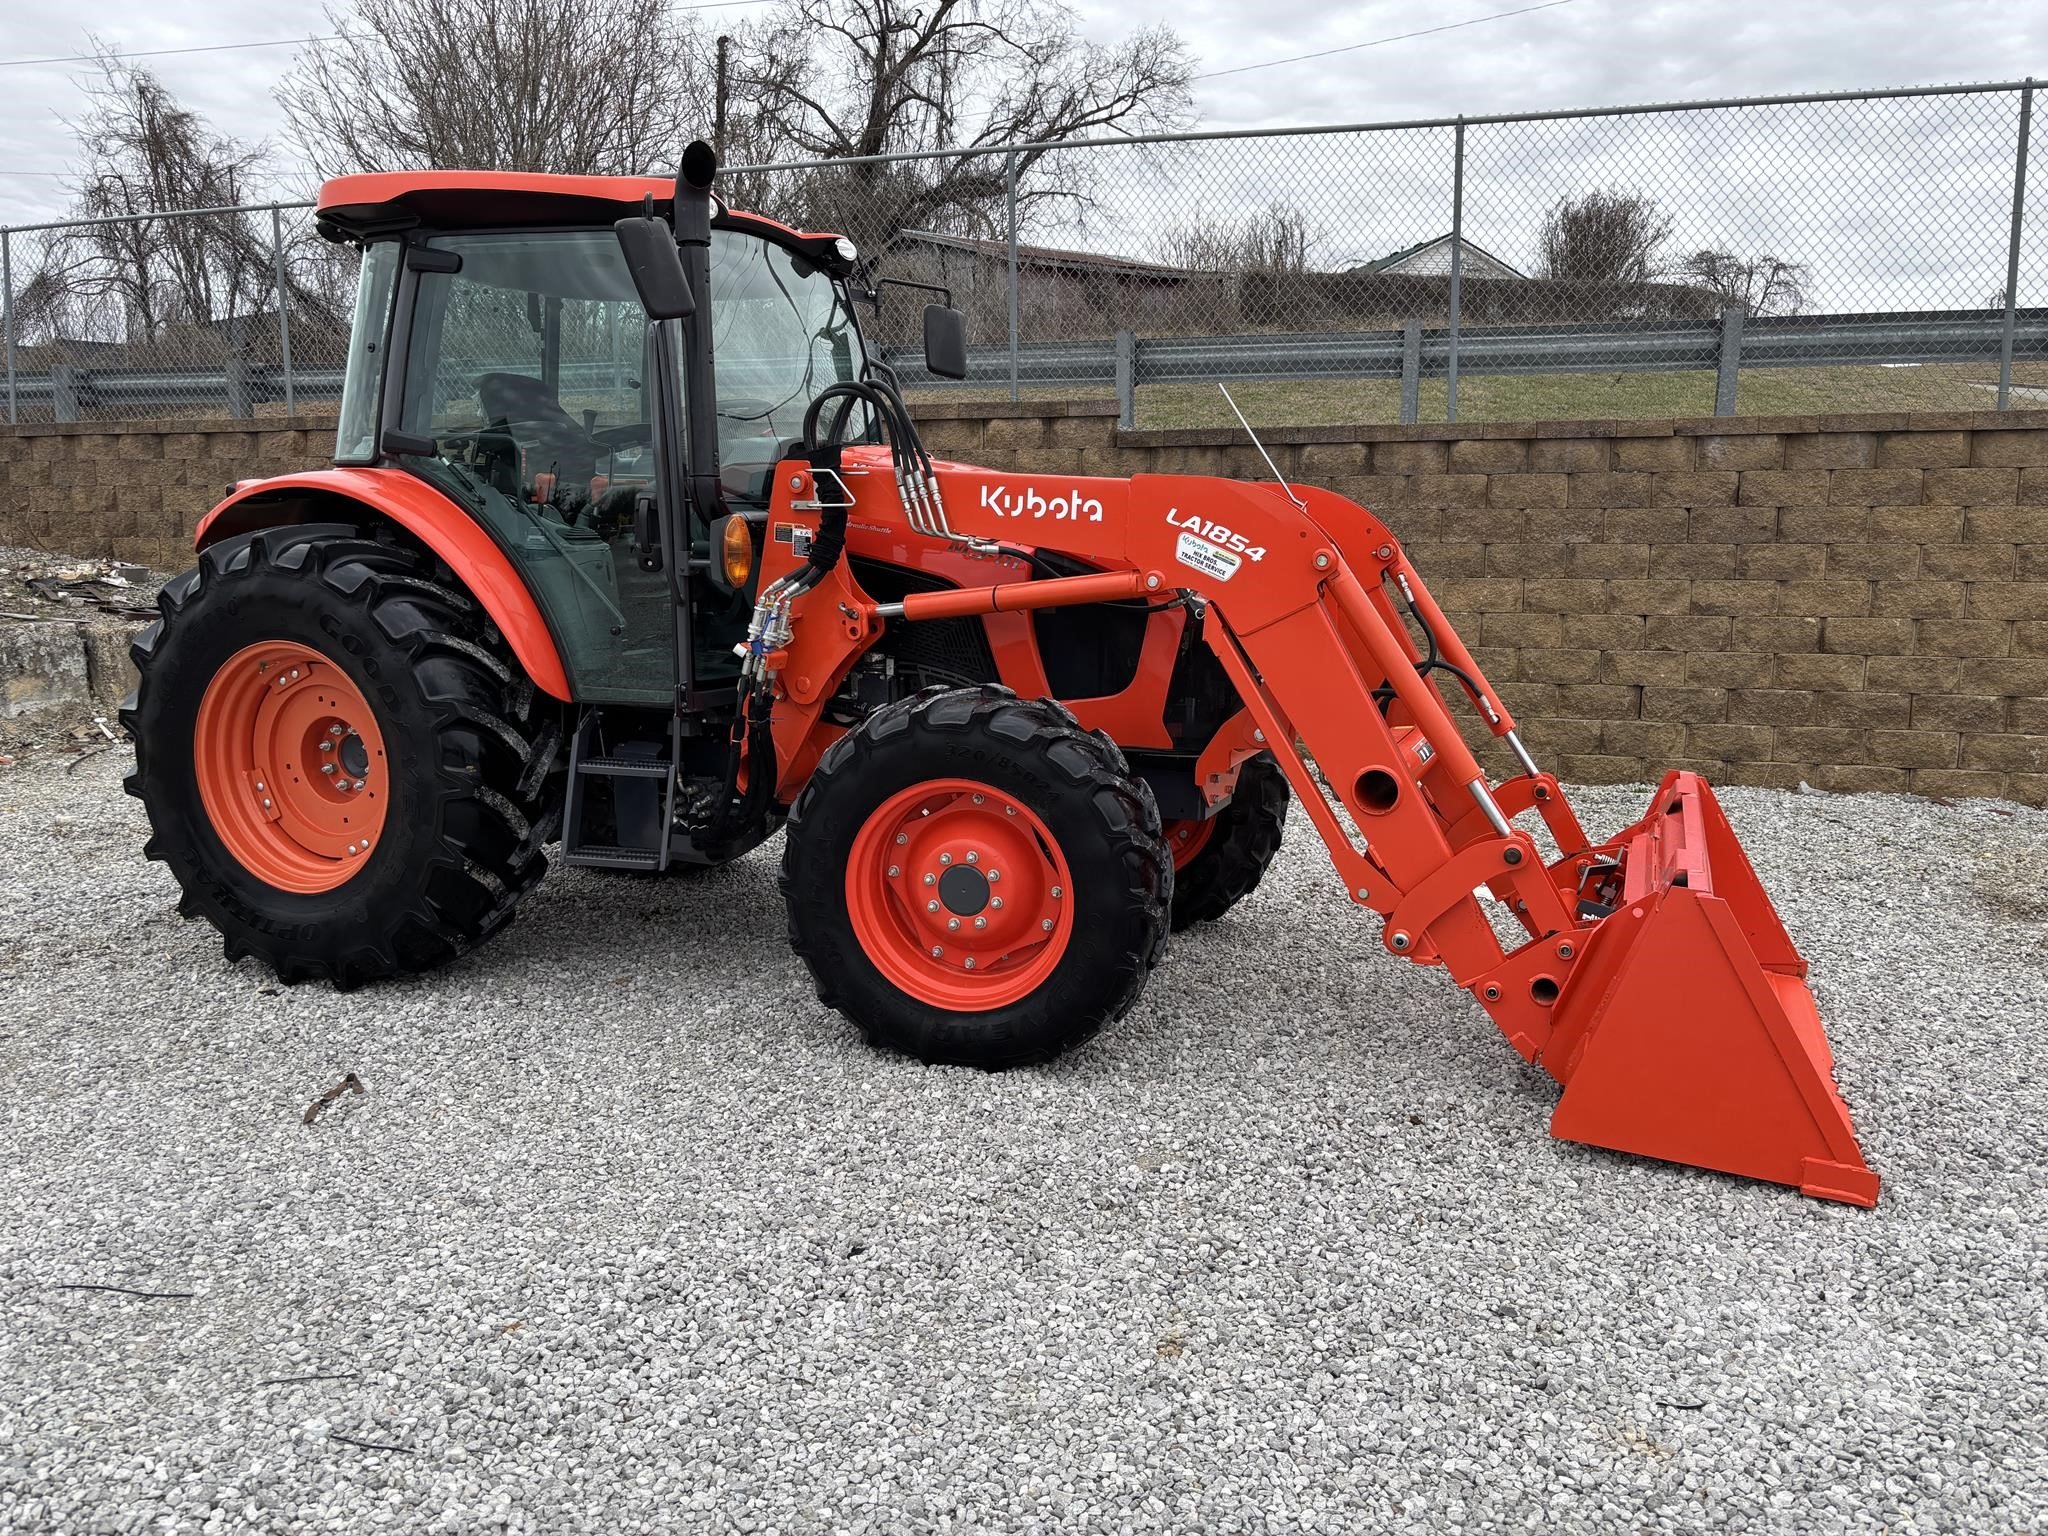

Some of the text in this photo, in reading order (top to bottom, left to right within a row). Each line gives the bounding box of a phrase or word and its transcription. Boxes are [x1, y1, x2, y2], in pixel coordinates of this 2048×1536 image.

[980, 485, 1103, 522] Kubota
[1166, 507, 1267, 562] LA1854
[1182, 535, 1209, 553] Kubota
[1181, 551, 1204, 567] TRACTOR
[1204, 563, 1226, 577] SERVICE
[1203, 554, 1218, 566] BROS.
